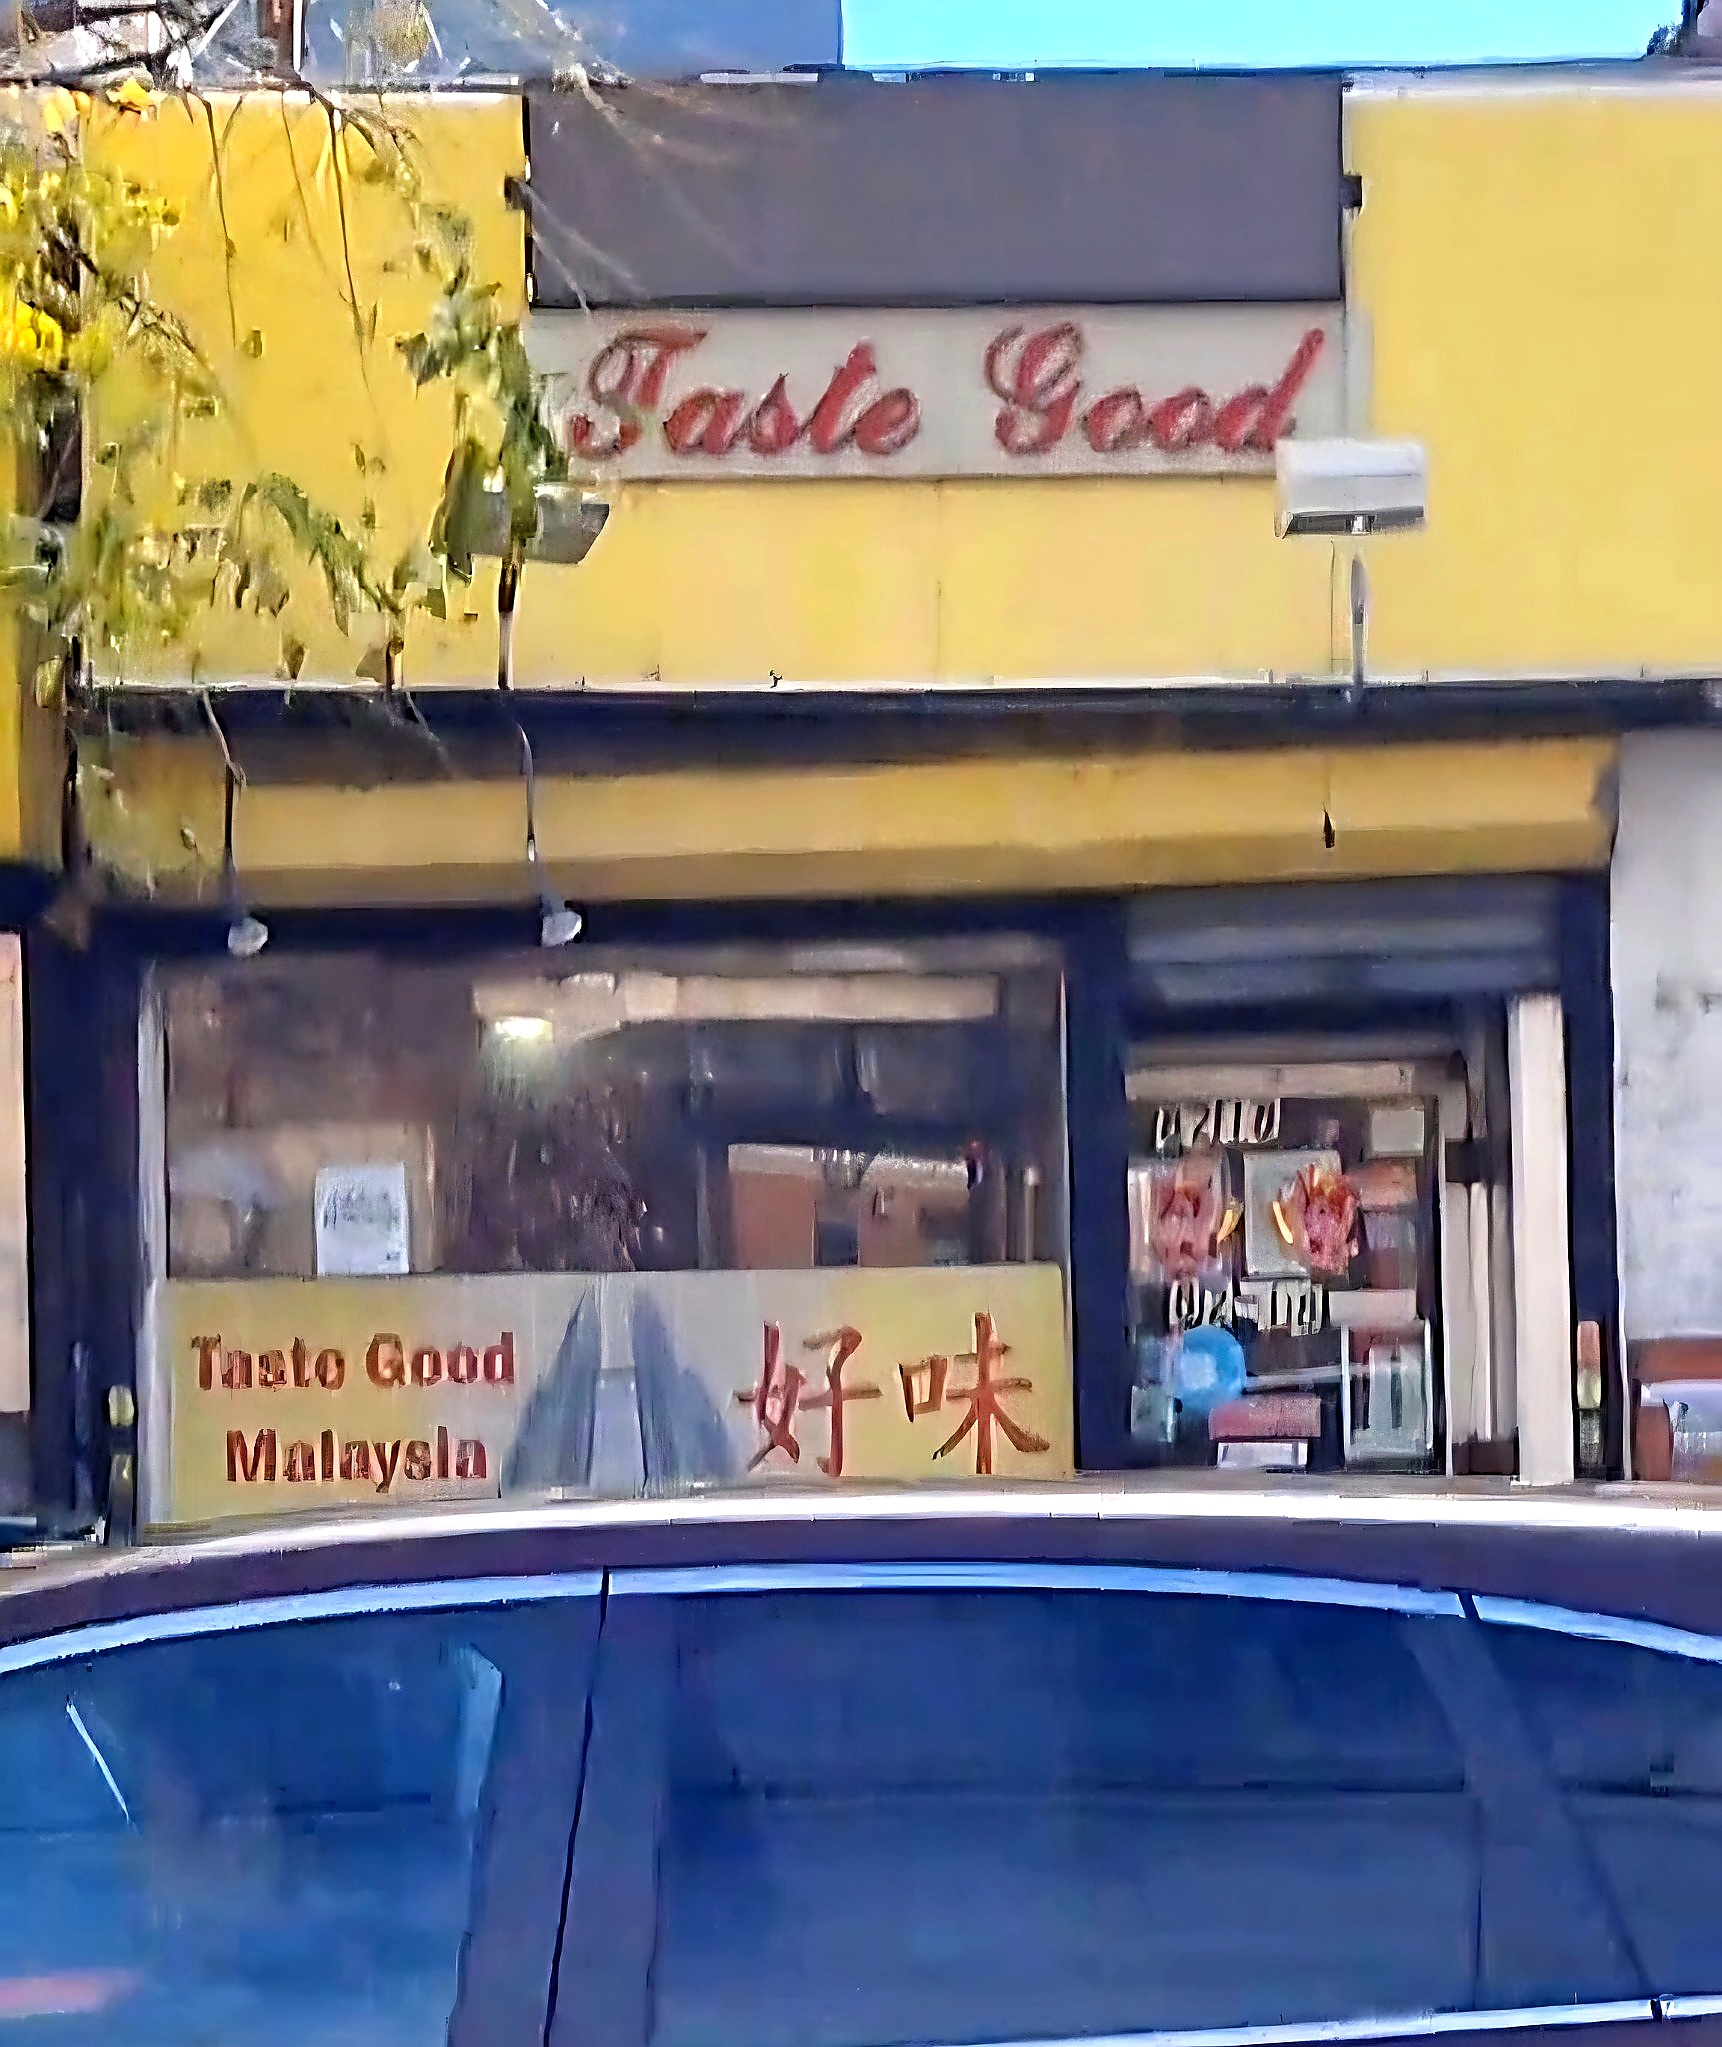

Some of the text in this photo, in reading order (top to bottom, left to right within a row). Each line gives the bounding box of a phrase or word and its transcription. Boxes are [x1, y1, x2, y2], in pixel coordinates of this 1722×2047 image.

[572, 321, 1325, 459] Taste Good
[364, 1332, 516, 1388] Good
[733, 1312, 1051, 1478] 好味
